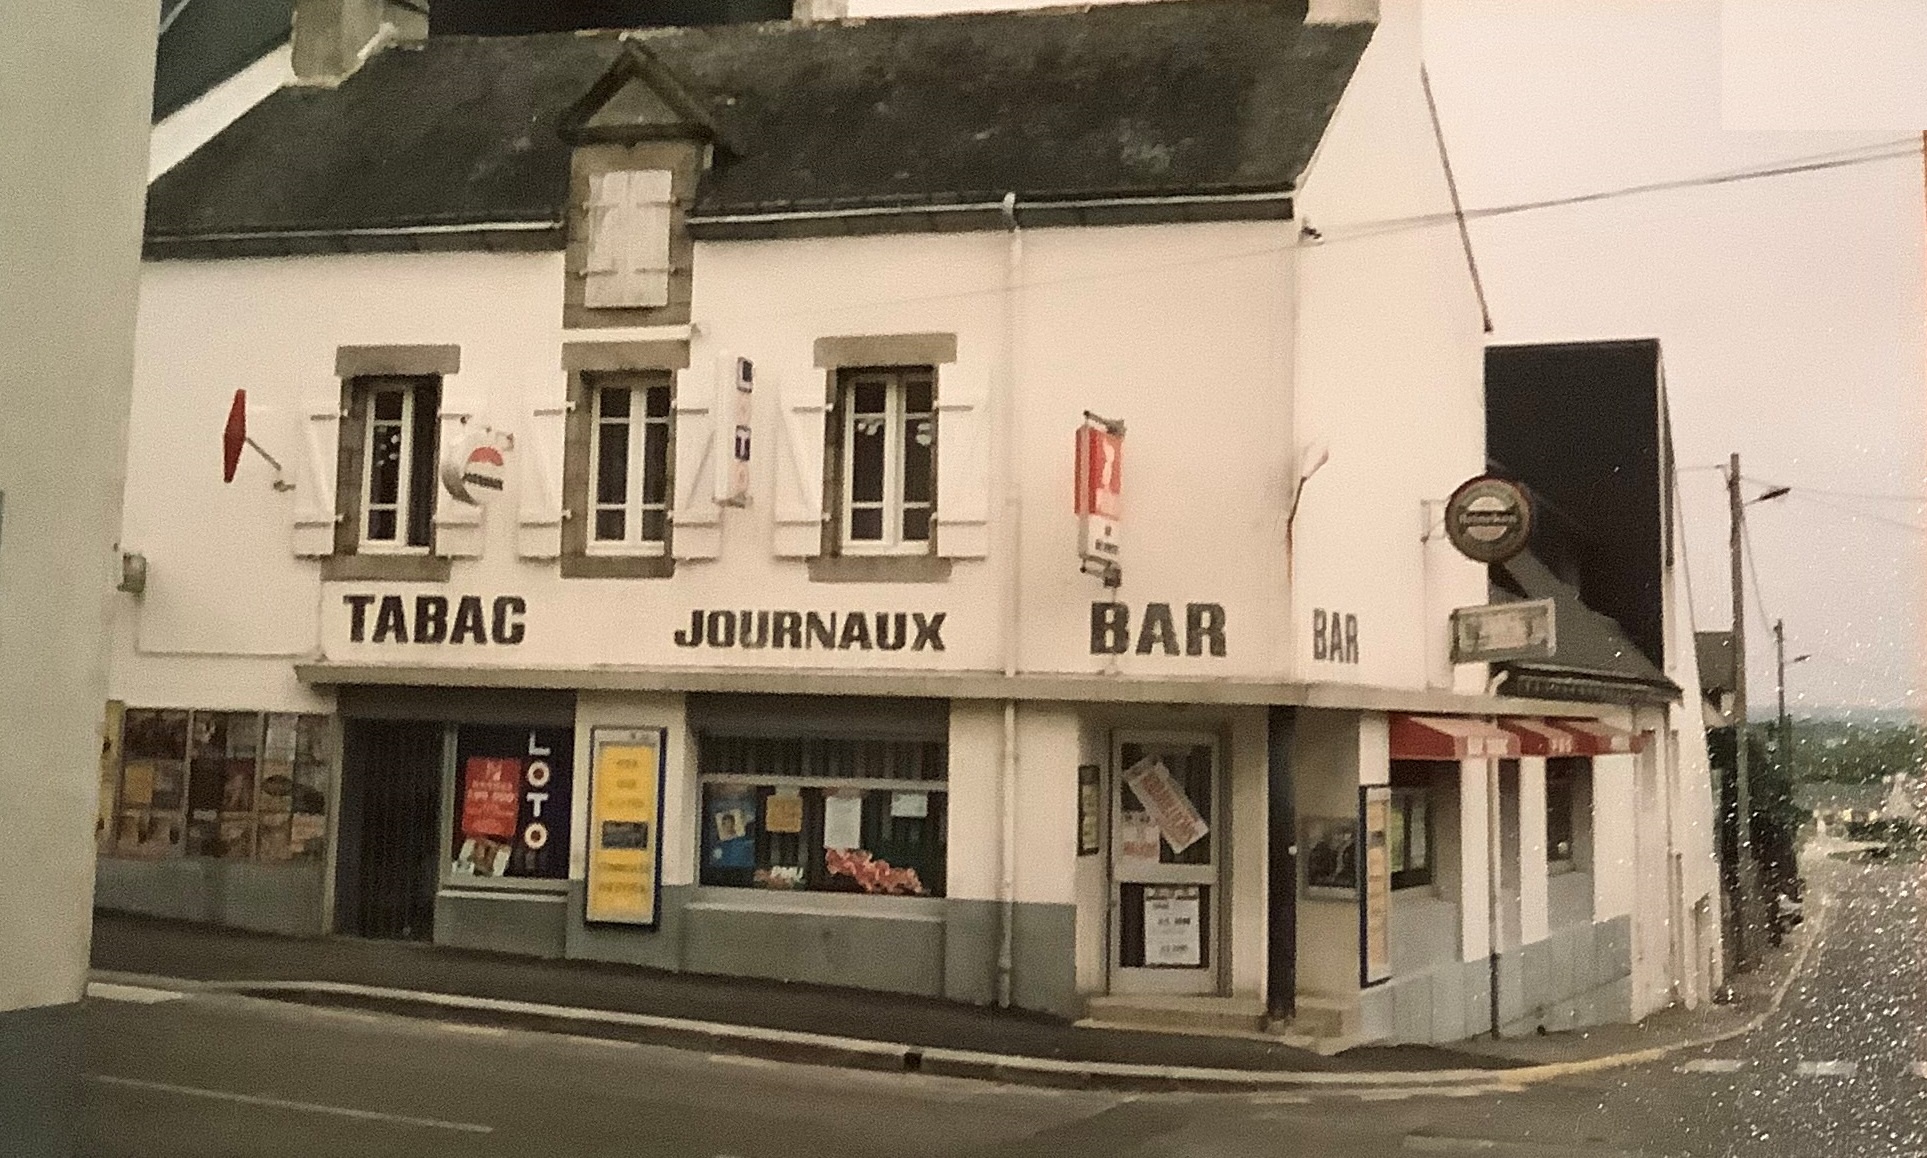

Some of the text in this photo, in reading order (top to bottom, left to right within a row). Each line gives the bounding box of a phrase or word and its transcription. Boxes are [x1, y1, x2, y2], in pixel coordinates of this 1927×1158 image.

[343, 595, 526, 645] TABAC
[674, 610, 947, 652] JOURNAUX
[1090, 602, 1227, 658] BAR
[1313, 608, 1360, 665] BAR
[524, 732, 551, 850] LOTO
